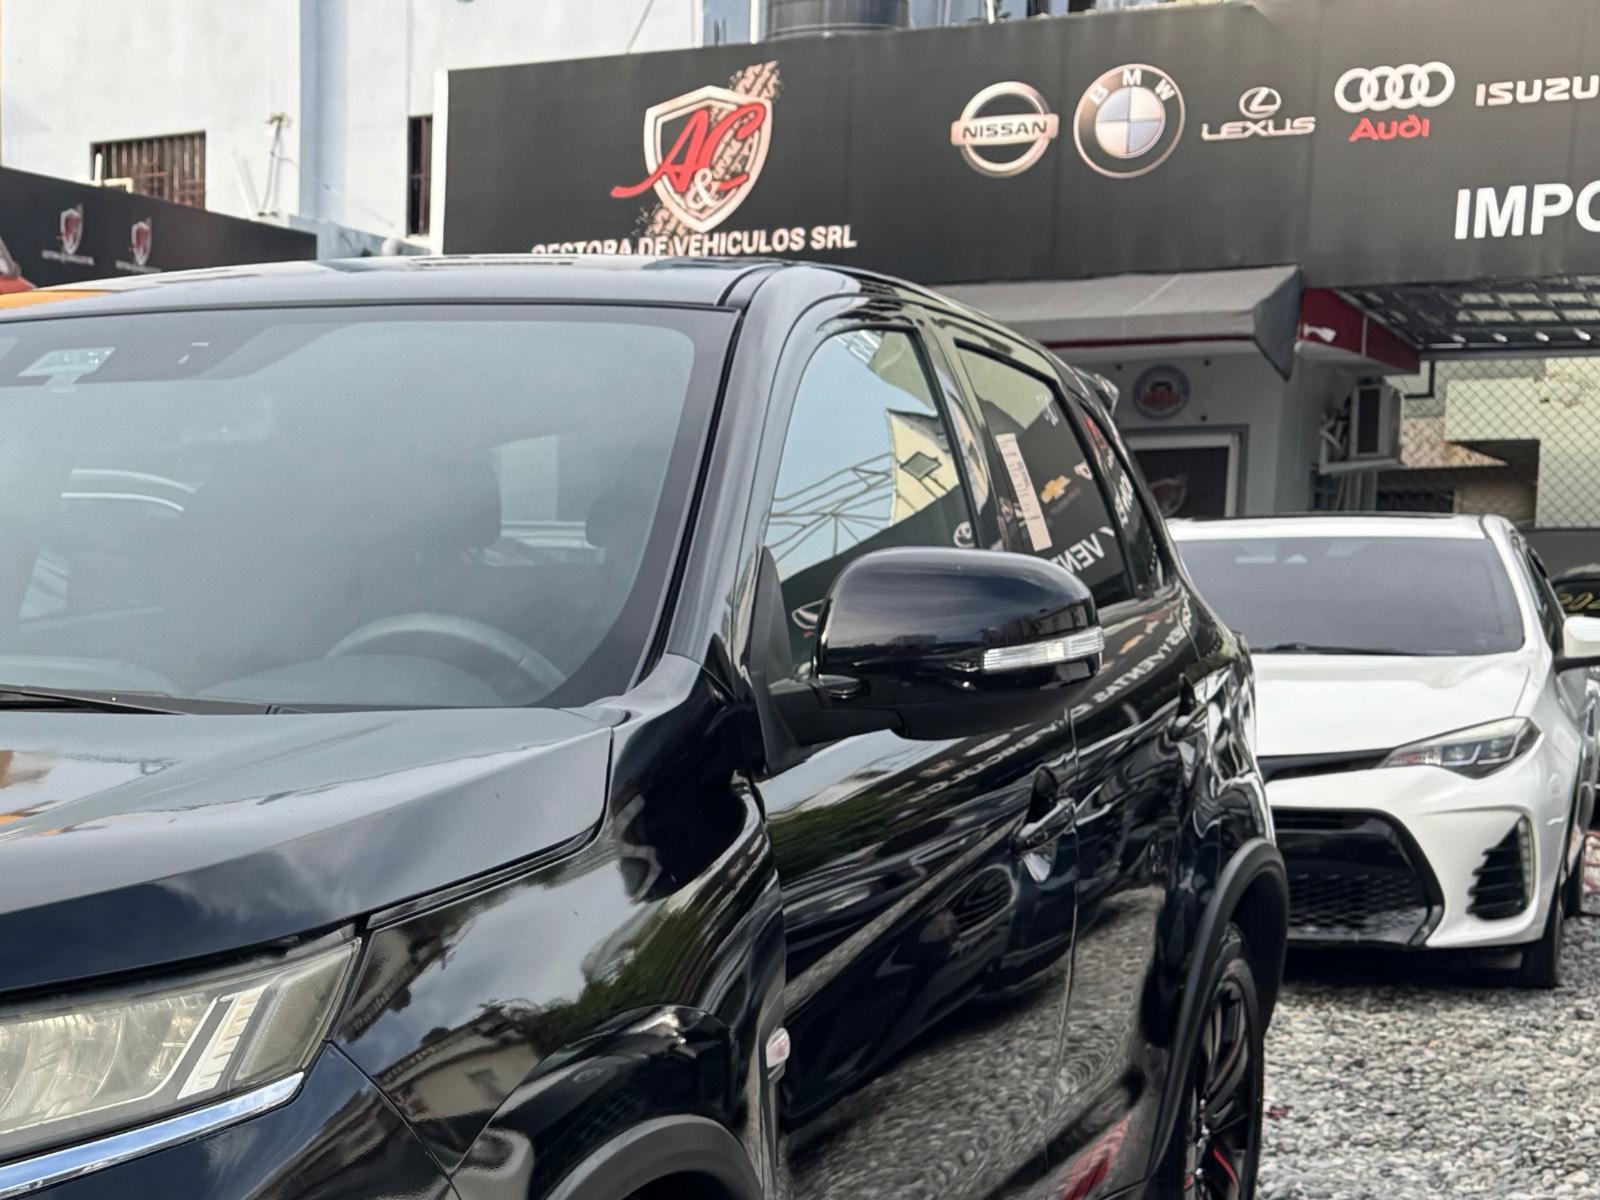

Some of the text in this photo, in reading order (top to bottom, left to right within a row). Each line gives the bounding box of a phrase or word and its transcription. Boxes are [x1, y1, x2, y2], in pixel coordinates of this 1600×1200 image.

[1088, 67, 1176, 105] BMW
[1475, 75, 1599, 107] ISUZU
[962, 121, 1048, 139] NISSAN
[1201, 116, 1316, 141] LEXUS
[1348, 113, 1430, 142] Audi
[638, 235, 669, 256] DE
[672, 229, 806, 256] VEHICULOS
[810, 224, 858, 250] SRL
